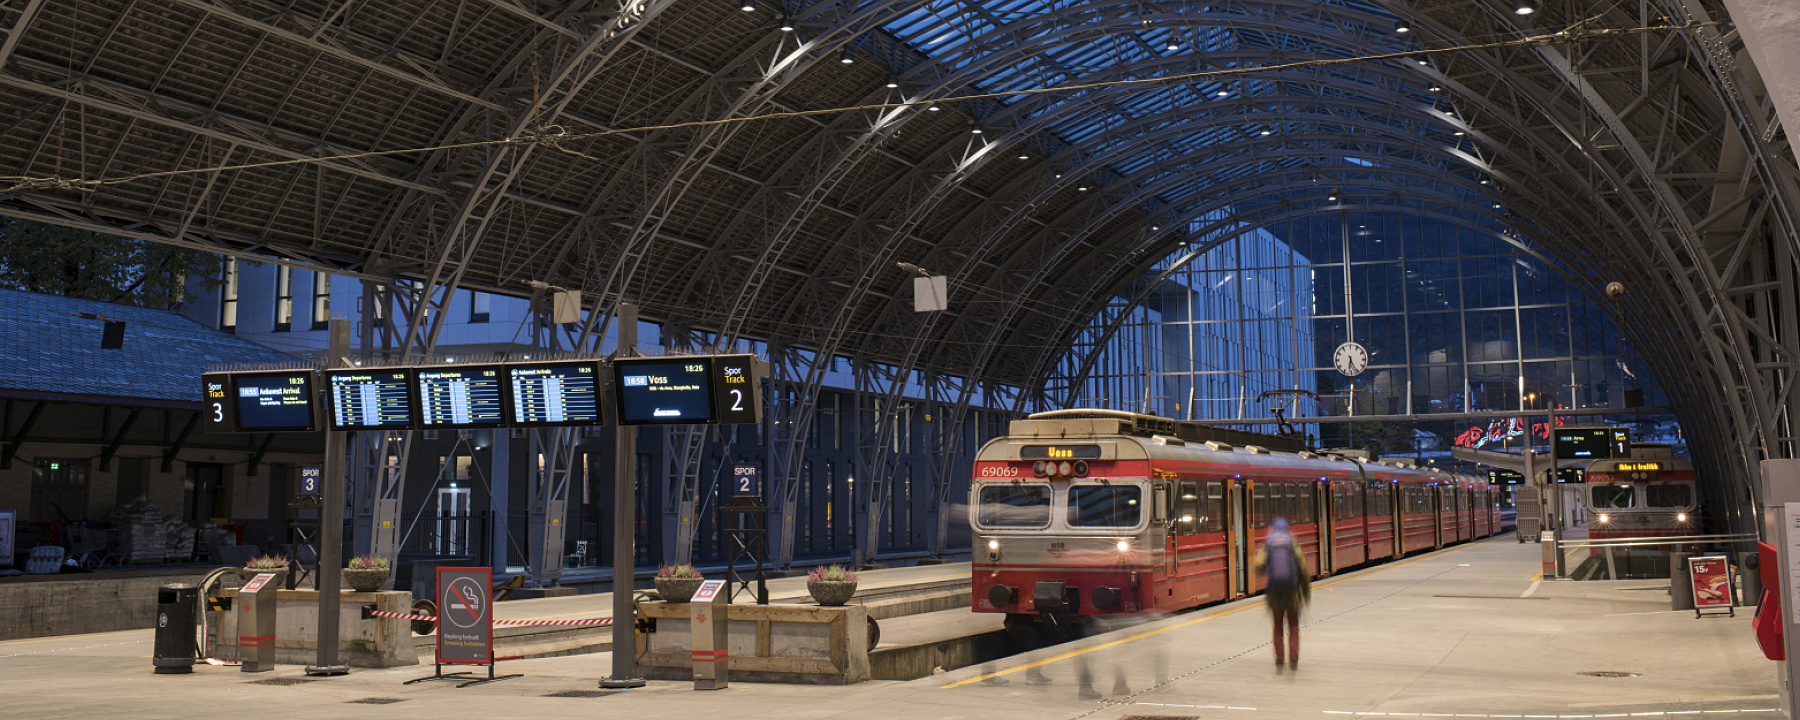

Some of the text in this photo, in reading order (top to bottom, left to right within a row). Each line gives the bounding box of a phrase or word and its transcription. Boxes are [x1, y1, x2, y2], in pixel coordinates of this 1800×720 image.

[724, 366, 742, 374] Spor
[648, 376, 668, 384] Voss
[724, 375, 745, 384] Track
[208, 382, 222, 391] Spor
[208, 390, 225, 398] Track
[730, 390, 744, 411] 2
[213, 402, 223, 422] 3
[1048, 447, 1072, 458] Voss
[1618, 443, 1623, 453] 1
[734, 468, 755, 476] SPOR
[982, 466, 1018, 476] 69069
[306, 478, 314, 491] 3
[740, 477, 750, 492] 2
